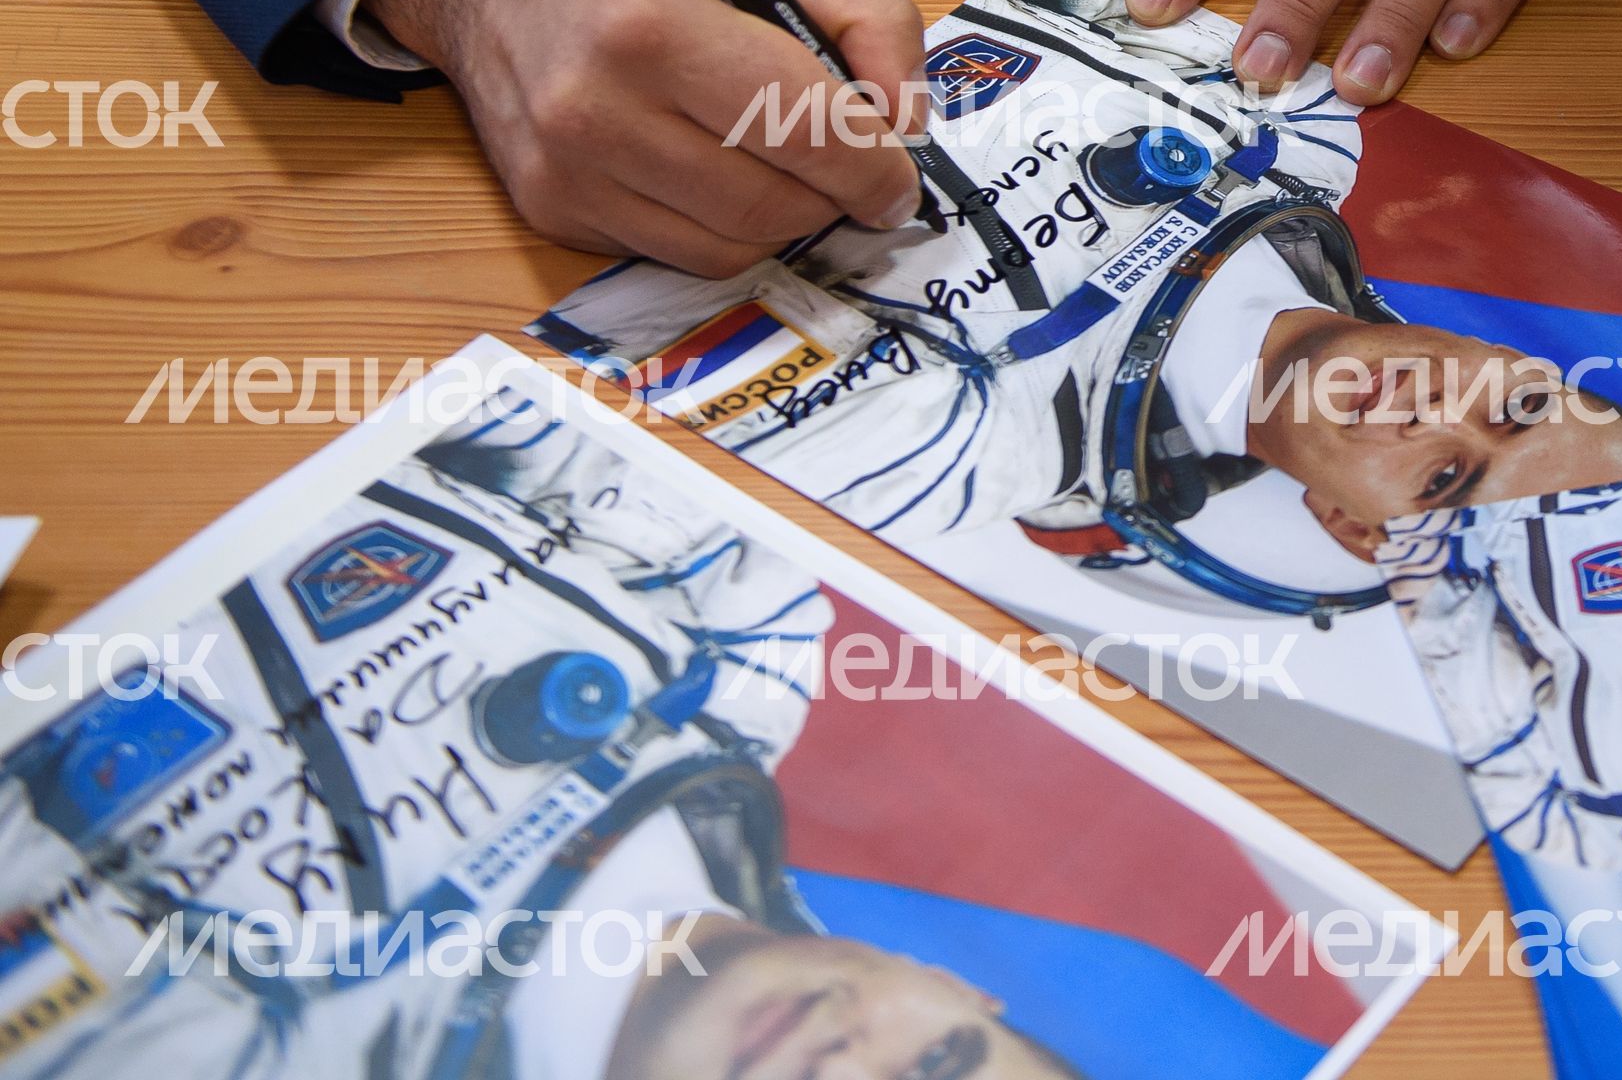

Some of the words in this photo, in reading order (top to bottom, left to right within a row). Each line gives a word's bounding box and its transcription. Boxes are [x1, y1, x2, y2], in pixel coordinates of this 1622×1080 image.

[924, 182, 1110, 320] Берту
[1101, 227, 1173, 285] KORSAKOV
[1115, 236, 1188, 294] КОРСАКОВ
[259, 742, 499, 918] Нилу
